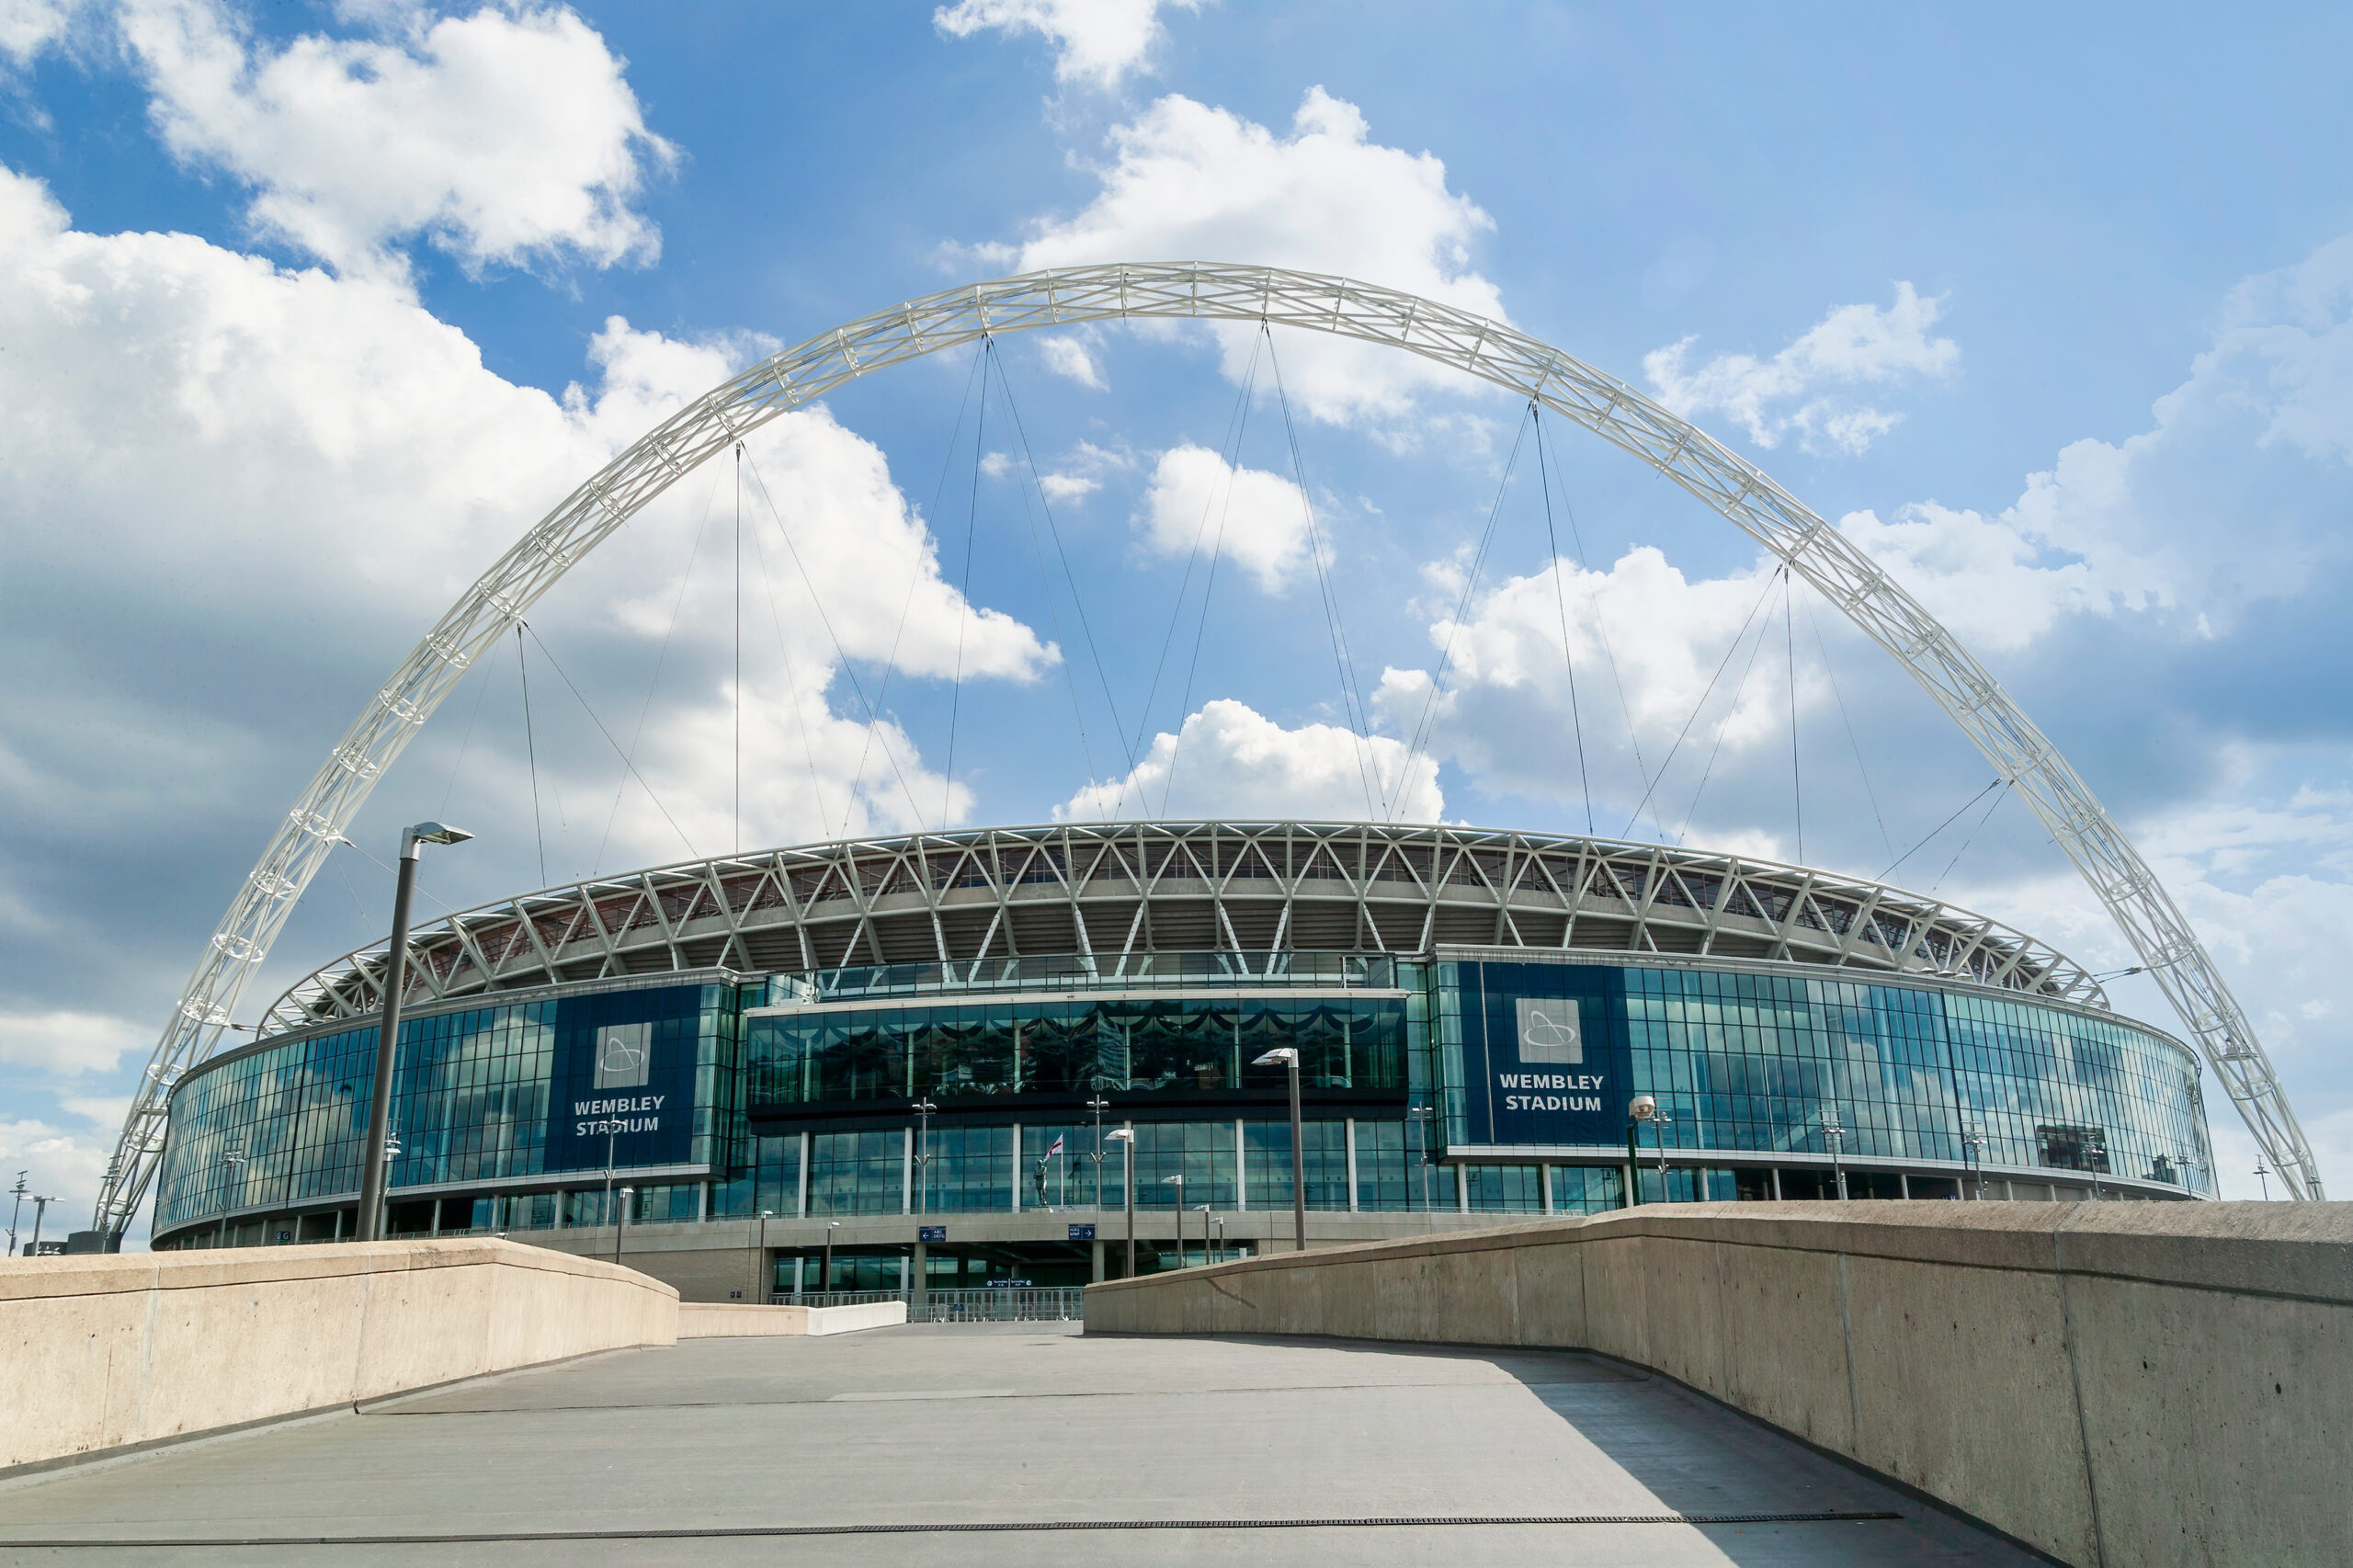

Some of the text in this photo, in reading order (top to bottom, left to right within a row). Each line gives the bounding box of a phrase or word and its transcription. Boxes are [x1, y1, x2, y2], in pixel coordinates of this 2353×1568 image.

[1500, 1074, 1604, 1090] WEMBLEY
[574, 1096, 665, 1116] WEMBLEY
[1506, 1096, 1601, 1111] STADIUM
